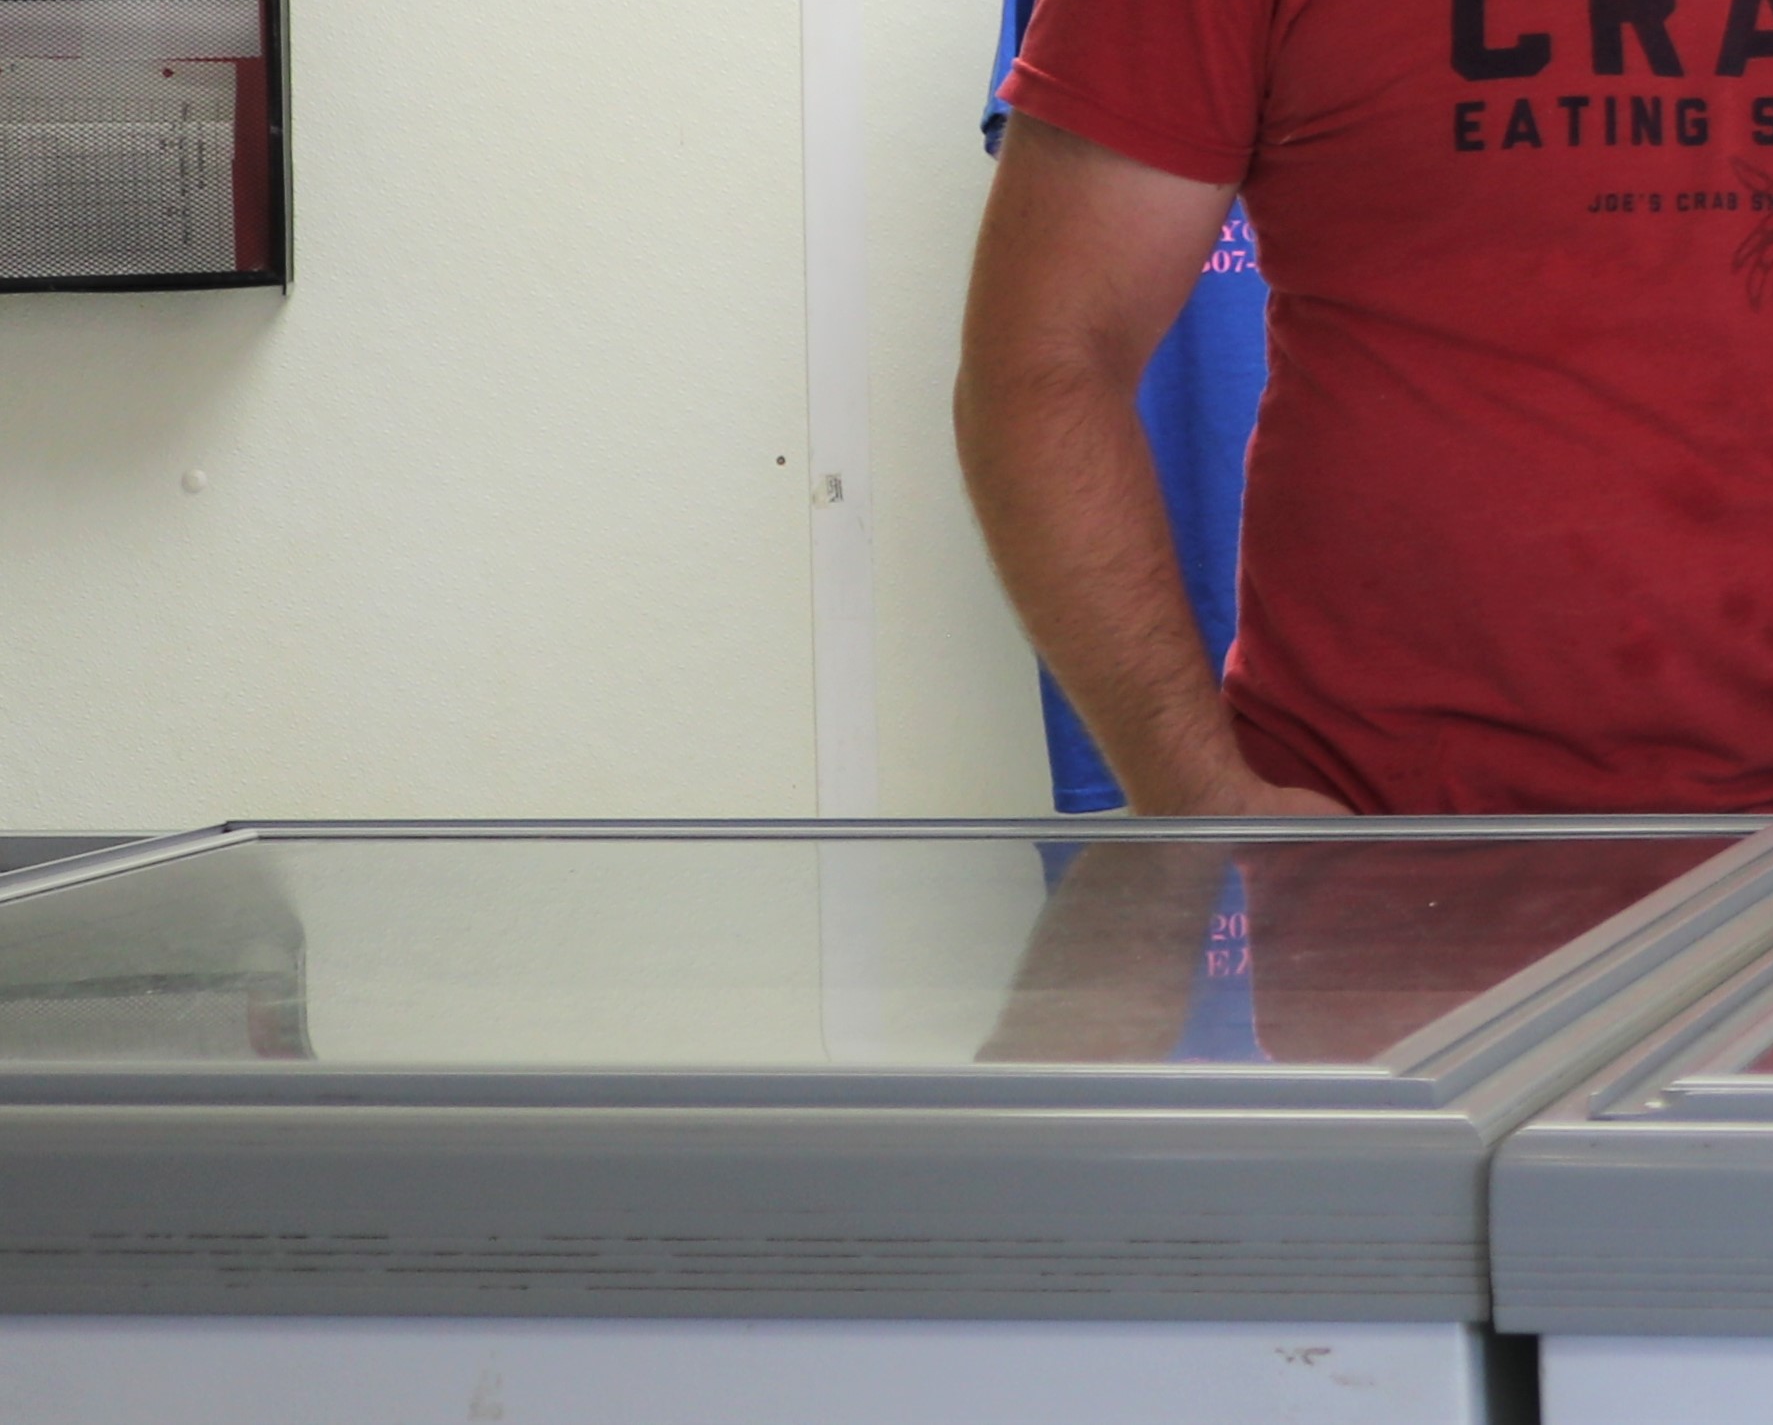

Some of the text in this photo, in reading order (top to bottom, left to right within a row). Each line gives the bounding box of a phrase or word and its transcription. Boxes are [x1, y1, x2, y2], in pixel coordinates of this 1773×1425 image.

[1453, 96, 1710, 153] EATING
[1587, 193, 1663, 213] JOE'S
[1676, 192, 1739, 212] CRAB
